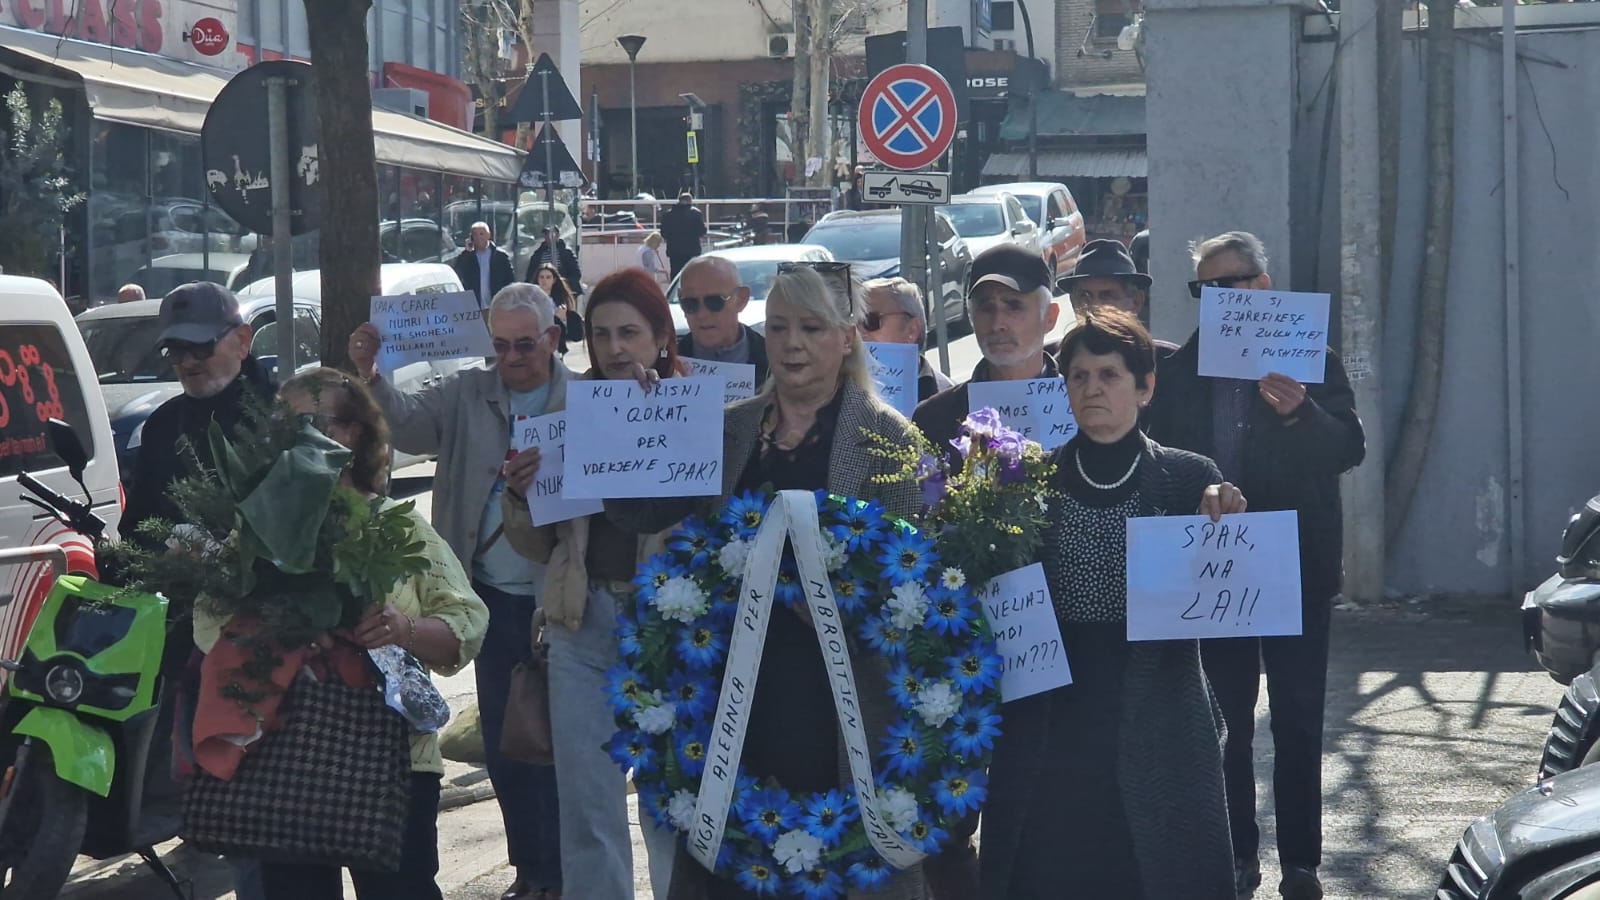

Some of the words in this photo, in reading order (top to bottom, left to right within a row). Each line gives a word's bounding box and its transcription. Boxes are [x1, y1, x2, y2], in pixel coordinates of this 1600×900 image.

[13, 0, 163, 53] CLASS
[1217, 292, 1252, 305] SPAK
[1269, 297, 1282, 308] SI
[434, 315, 448, 325] DO
[409, 328, 454, 339] SHOHESH
[1220, 324, 1242, 337] PER
[1241, 348, 1249, 357] E
[592, 385, 612, 398] KU
[627, 386, 631, 397] I
[524, 427, 541, 444] PA
[637, 434, 667, 449] PER
[659, 460, 718, 486] SPAK?
[1181, 522, 1255, 551] SPAK,
[1199, 559, 1234, 578] NA
[989, 589, 1045, 620] VELIAJ
[1180, 587, 1261, 626] LA!!
[694, 813, 715, 856] NGA
[712, 676, 745, 781] ALEANCA
[743, 589, 763, 631] PER
[851, 745, 864, 760] E
